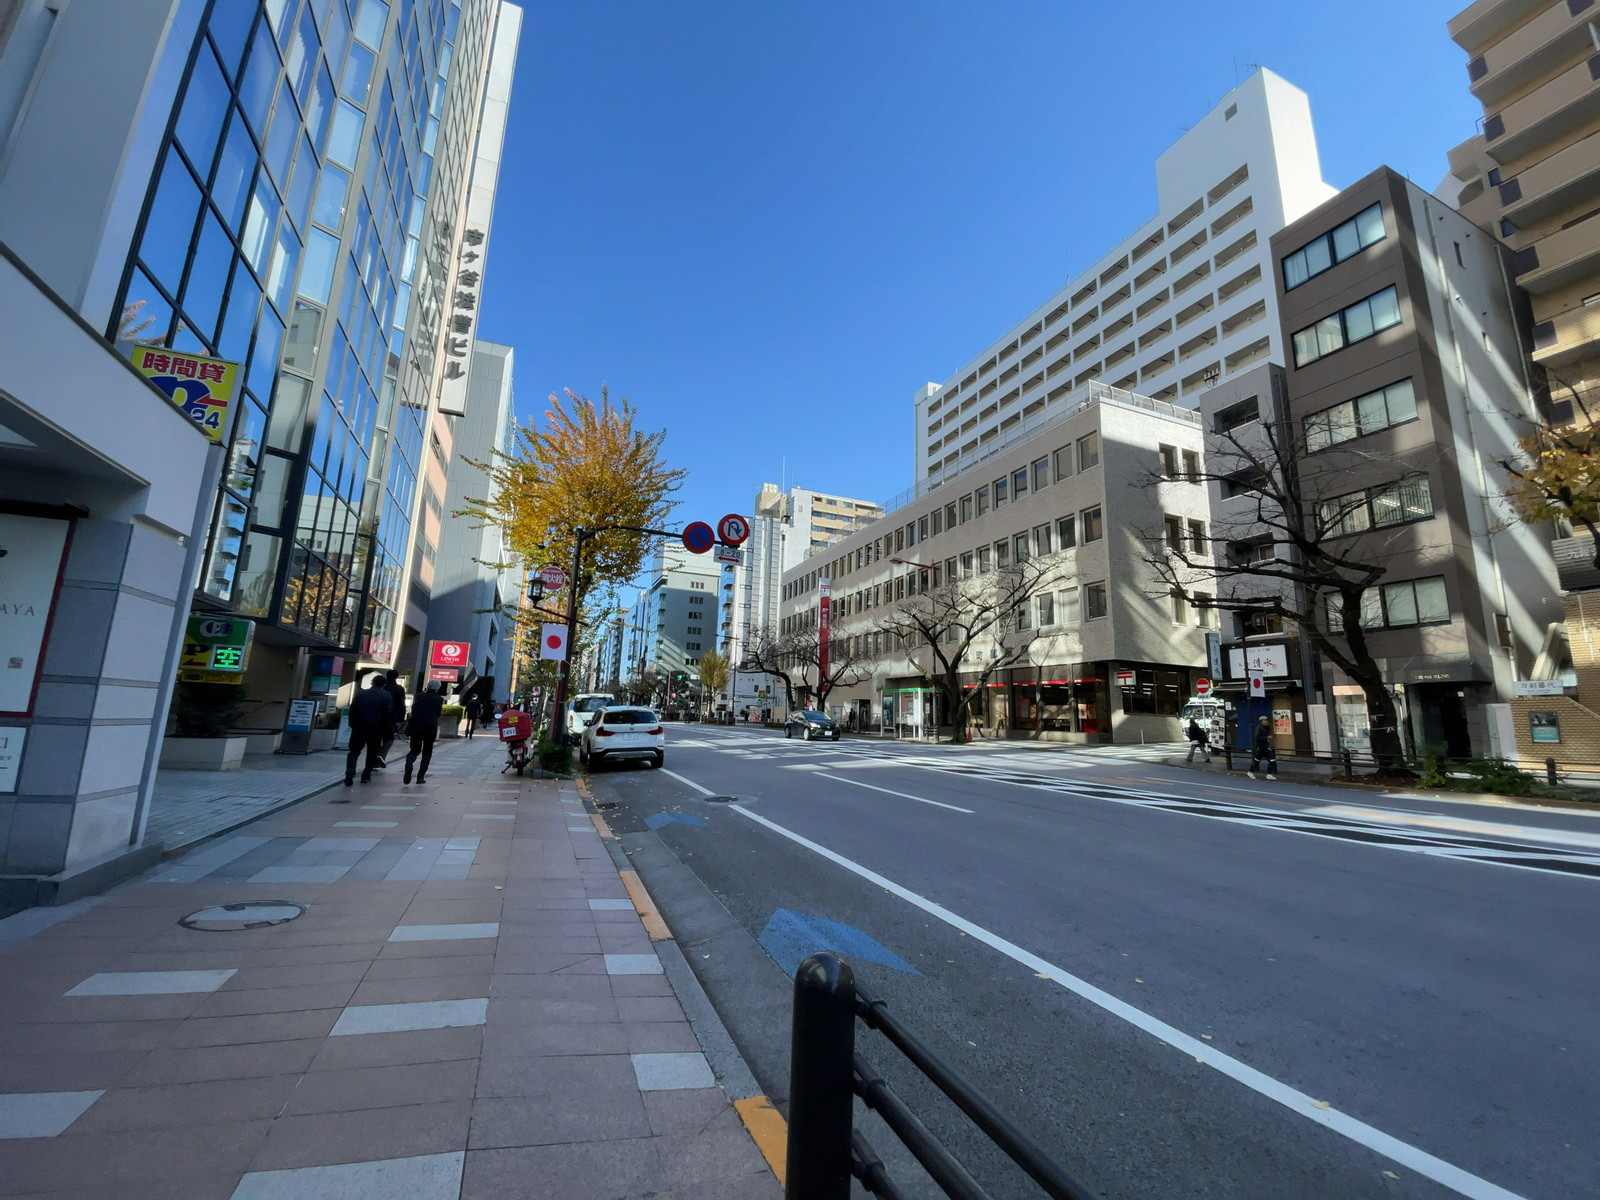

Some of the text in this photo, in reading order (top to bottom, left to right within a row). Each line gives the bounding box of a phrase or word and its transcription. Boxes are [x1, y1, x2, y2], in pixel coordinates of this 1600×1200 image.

[142, 352, 226, 383] 時間貸
[184, 642, 209, 655] P
[213, 648, 241, 668] 空
